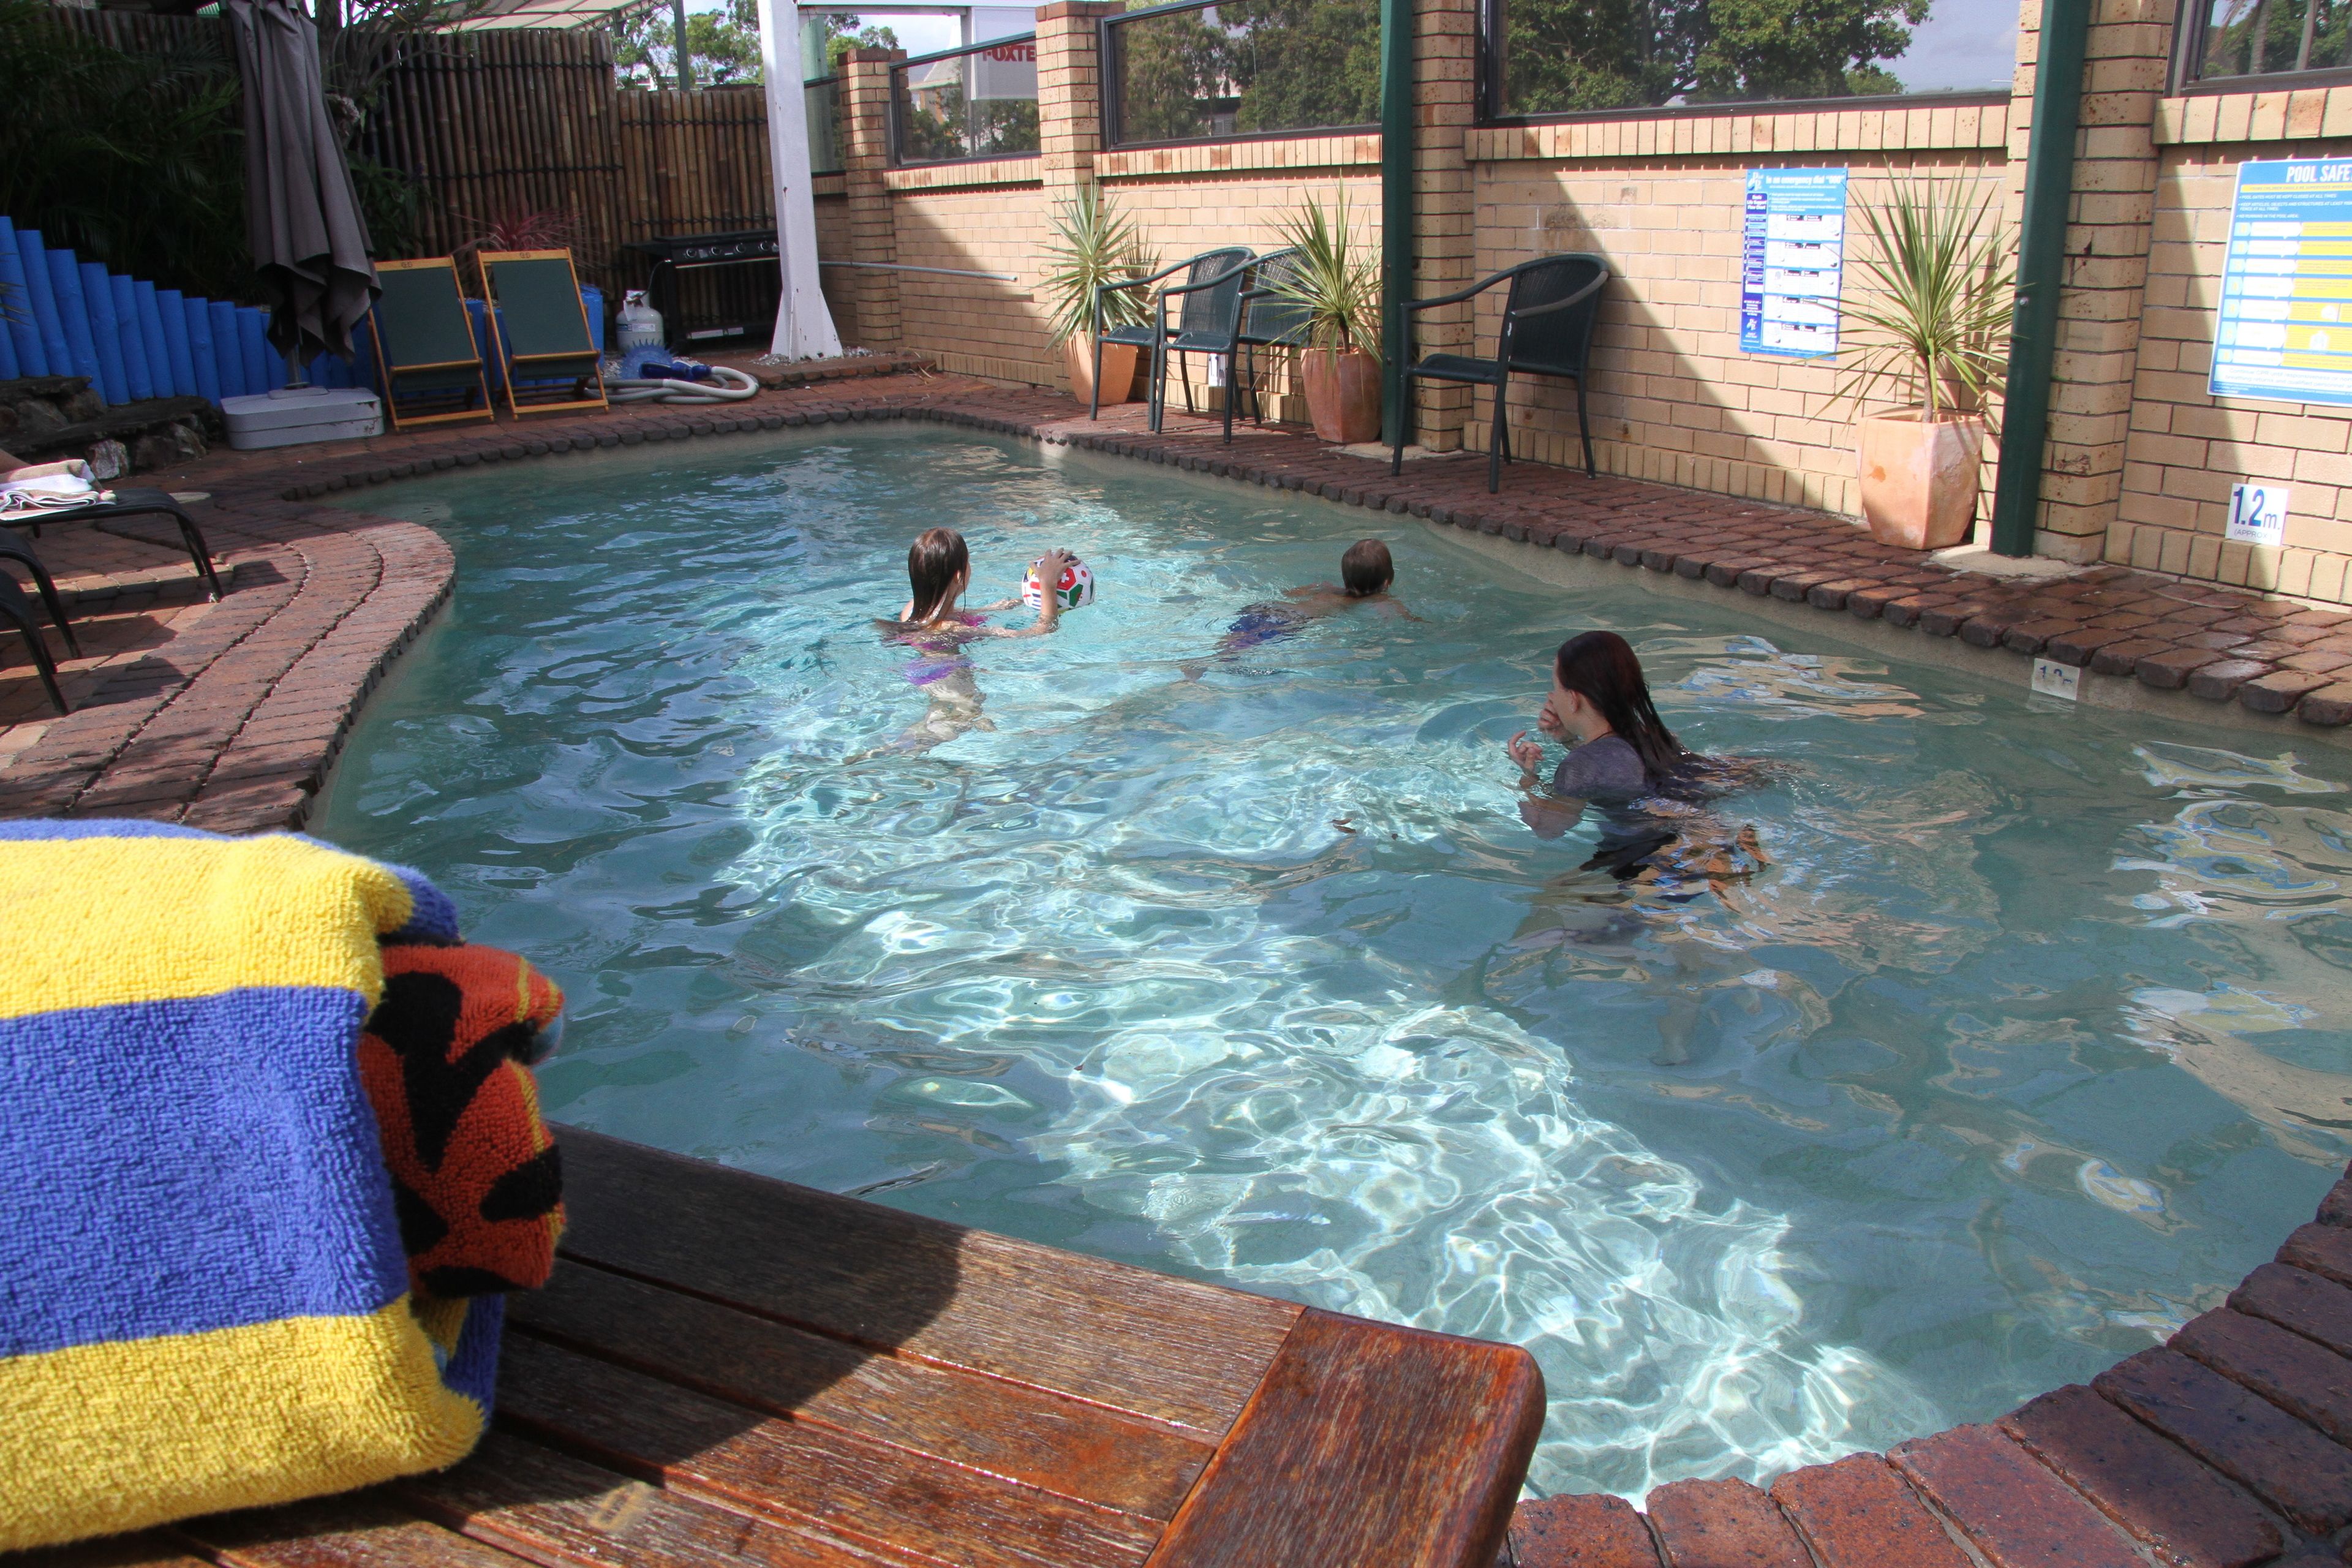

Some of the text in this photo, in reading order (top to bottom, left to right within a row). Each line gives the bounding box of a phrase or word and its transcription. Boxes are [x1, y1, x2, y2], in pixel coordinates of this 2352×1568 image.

[1781, 176, 1812, 185] emergency
[2286, 164, 2352, 183] POOL SAFE
